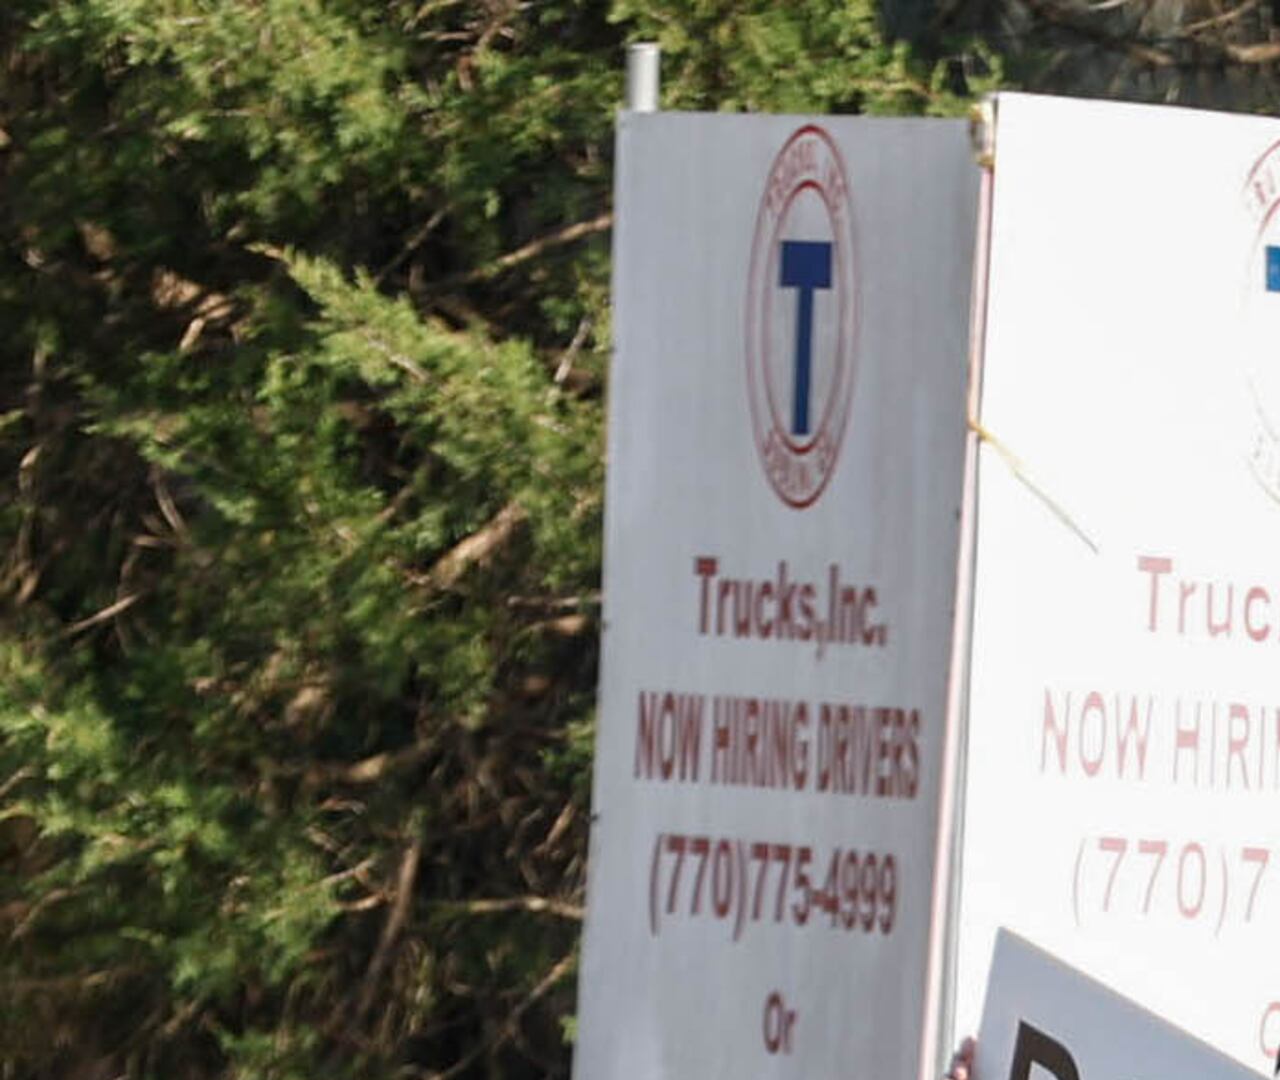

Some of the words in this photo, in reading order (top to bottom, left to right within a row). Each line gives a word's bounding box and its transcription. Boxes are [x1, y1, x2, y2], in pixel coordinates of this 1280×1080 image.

[635, 691, 701, 783] NOW
[710, 697, 808, 791] HIRING
[816, 706, 921, 800] DRIVERS
[1040, 687, 1153, 780] NOW
[763, 991, 796, 1055] Or
